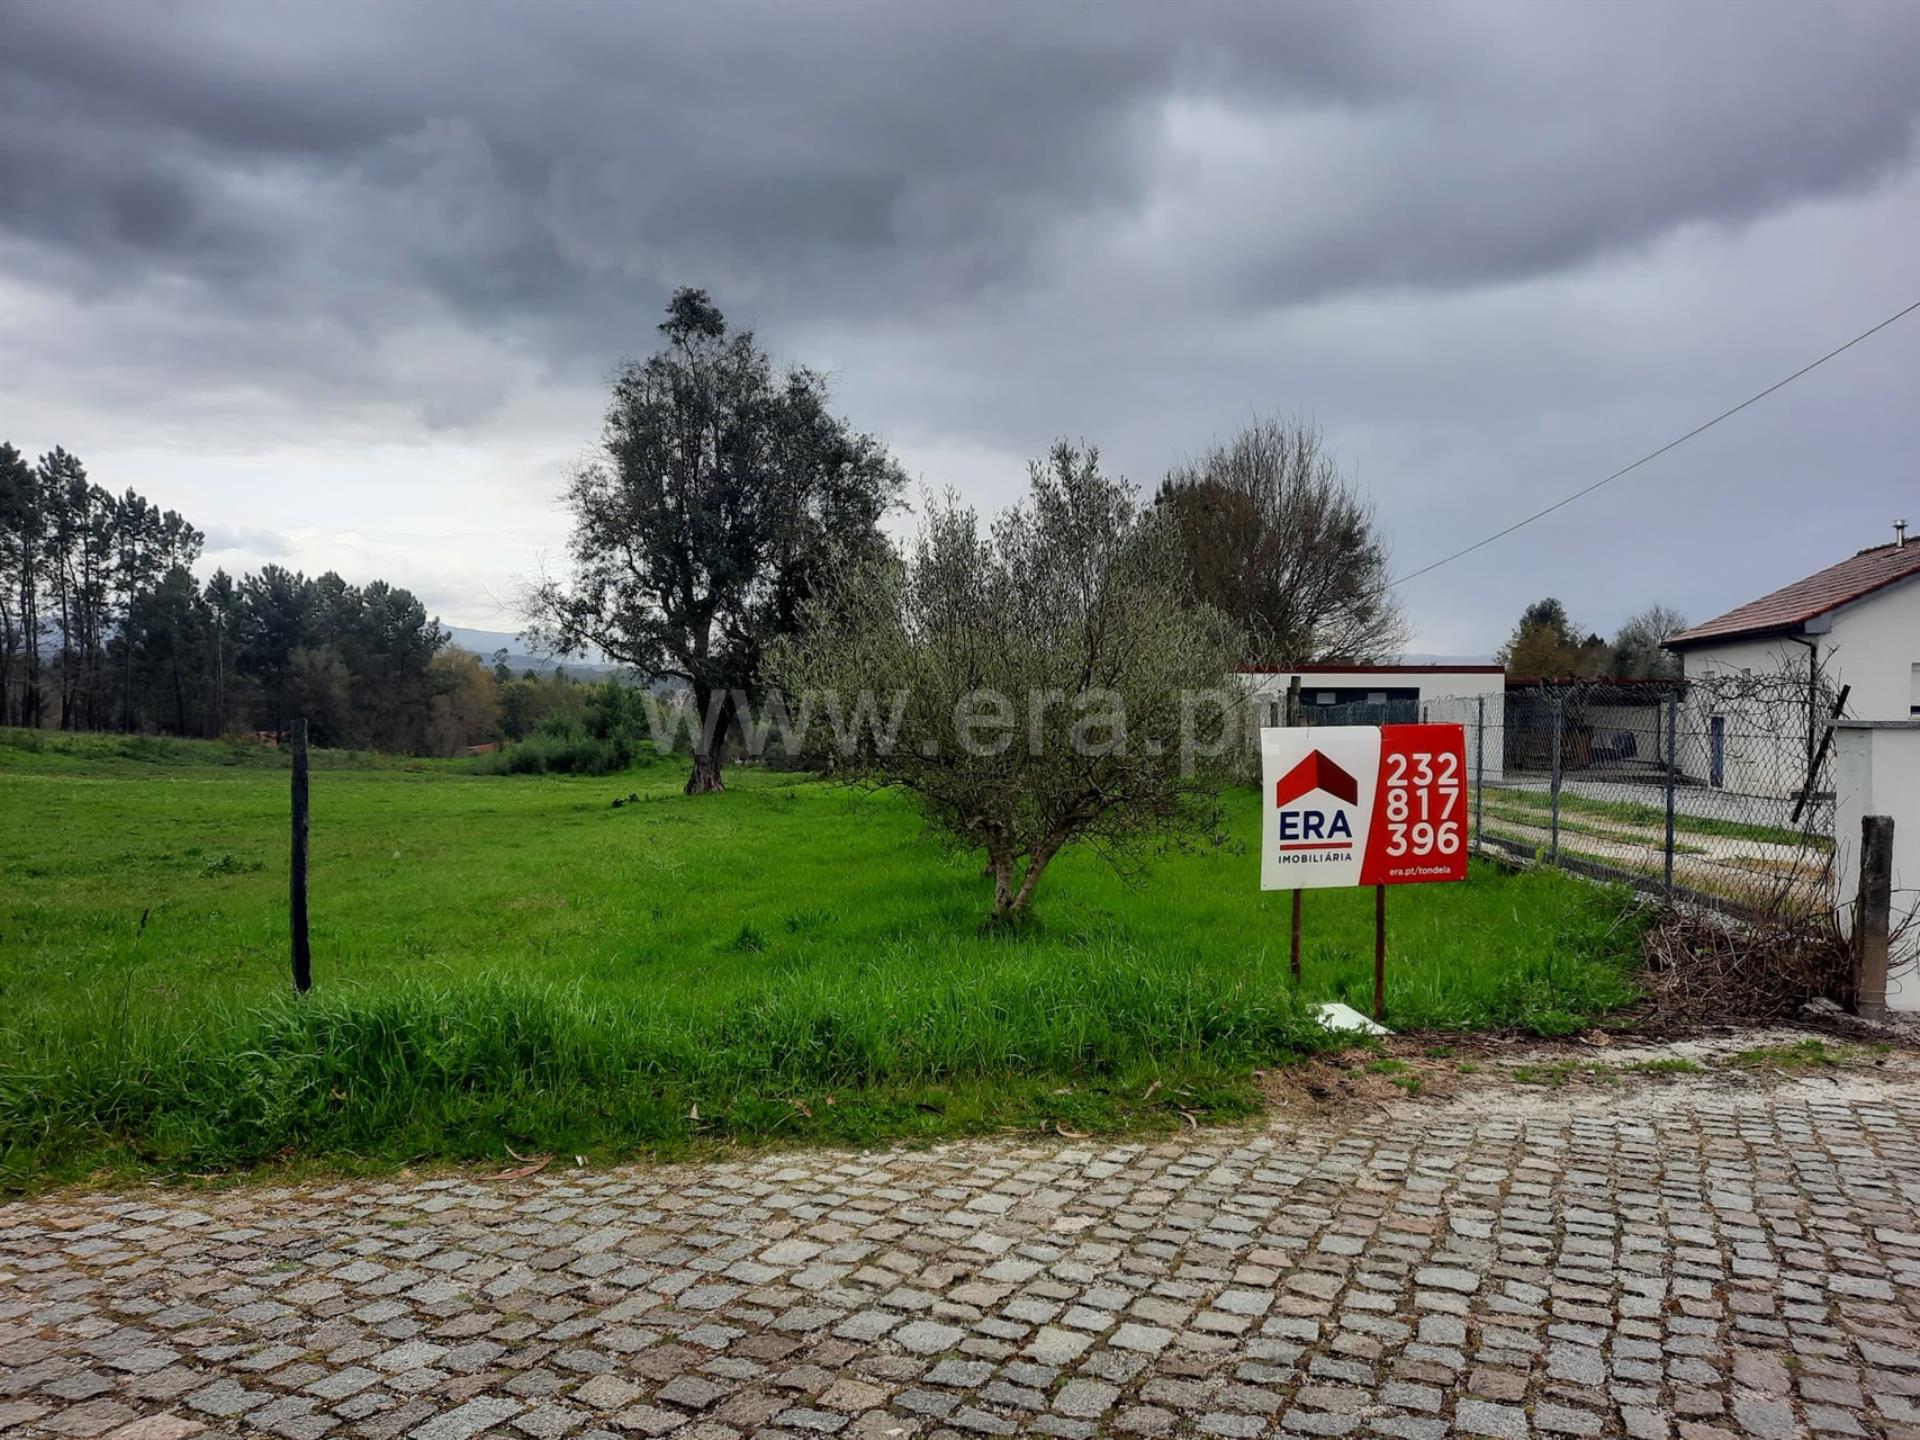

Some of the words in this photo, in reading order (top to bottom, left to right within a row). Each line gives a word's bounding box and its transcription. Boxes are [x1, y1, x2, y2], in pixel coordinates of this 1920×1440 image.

[1386, 753, 1459, 786] 232
[1386, 787, 1460, 821] 817
[1279, 810, 1353, 841] ERA
[1386, 822, 1460, 856] 396
[1278, 852, 1353, 864] IMOBILIÁRIA
[1389, 866, 1451, 877] era.pt/tondela
